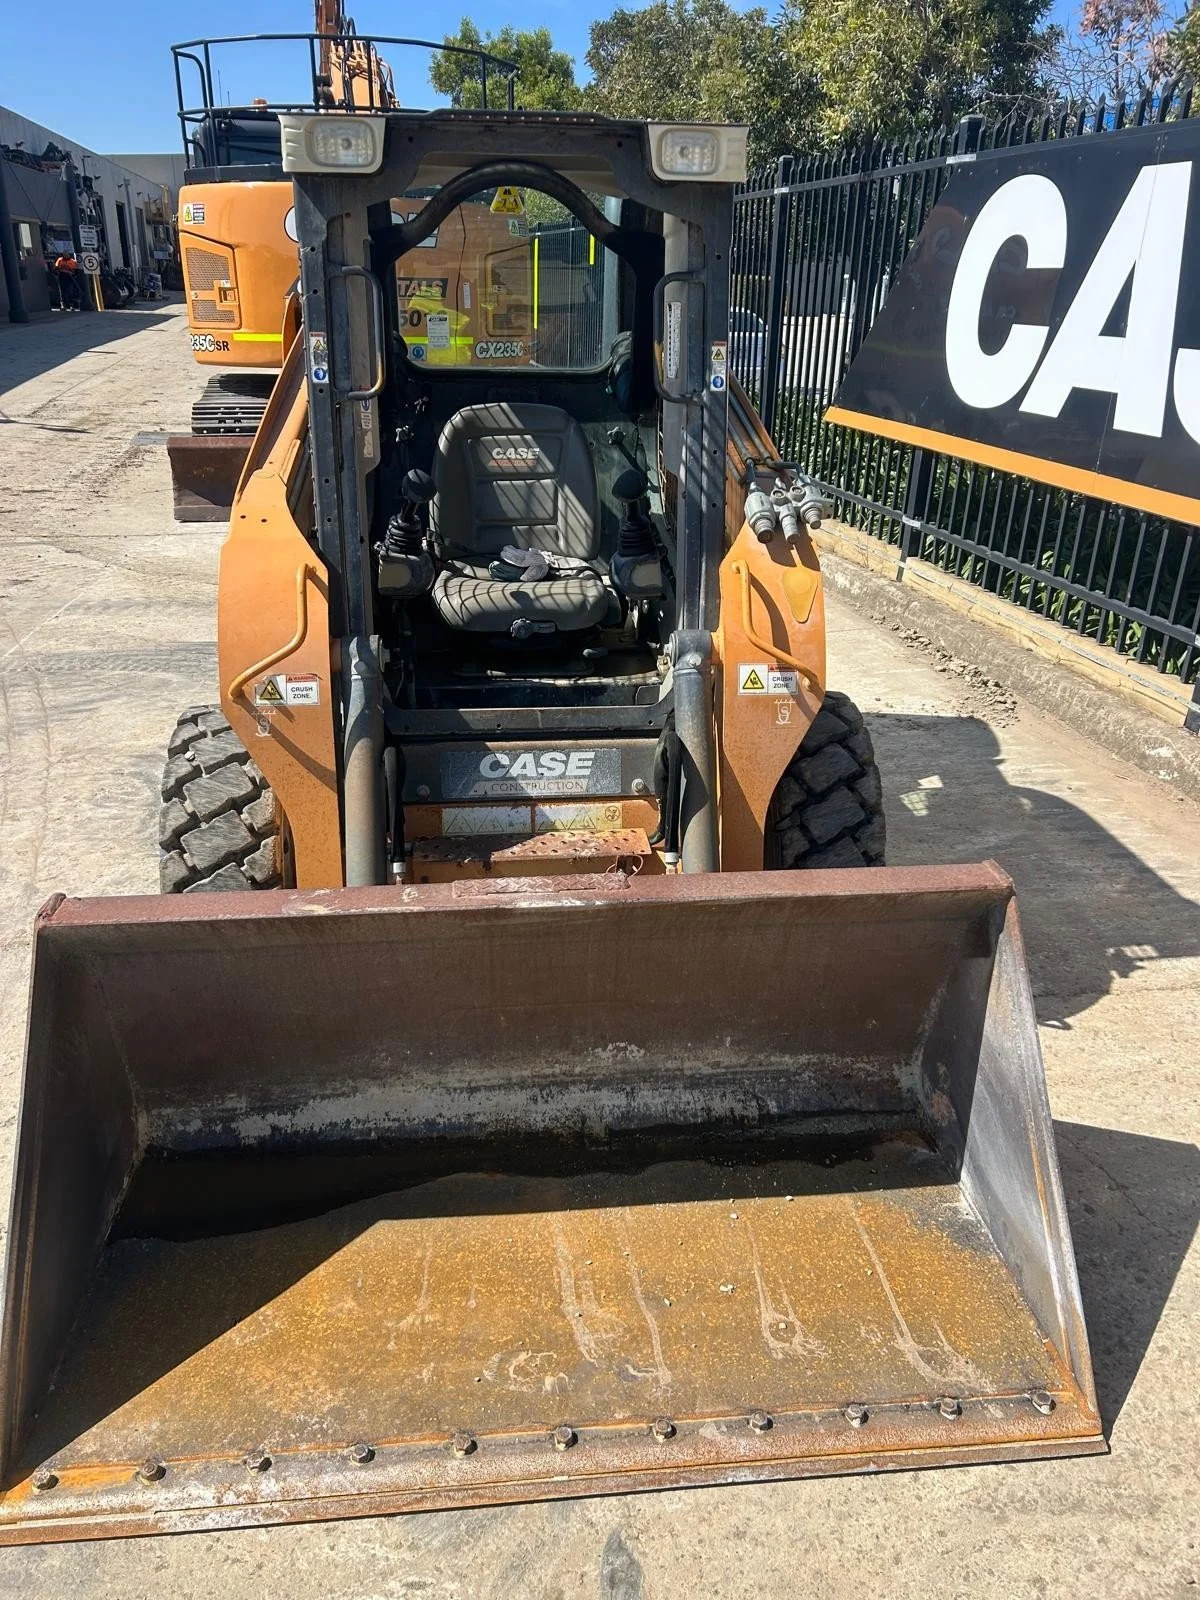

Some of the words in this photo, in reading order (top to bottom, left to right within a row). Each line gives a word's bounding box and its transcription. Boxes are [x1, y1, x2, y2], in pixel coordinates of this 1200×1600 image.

[87, 258, 94, 268] 5
[491, 447, 540, 459] CASE
[479, 751, 596, 779] CASE
[491, 780, 584, 793] CONSTRUCTION
